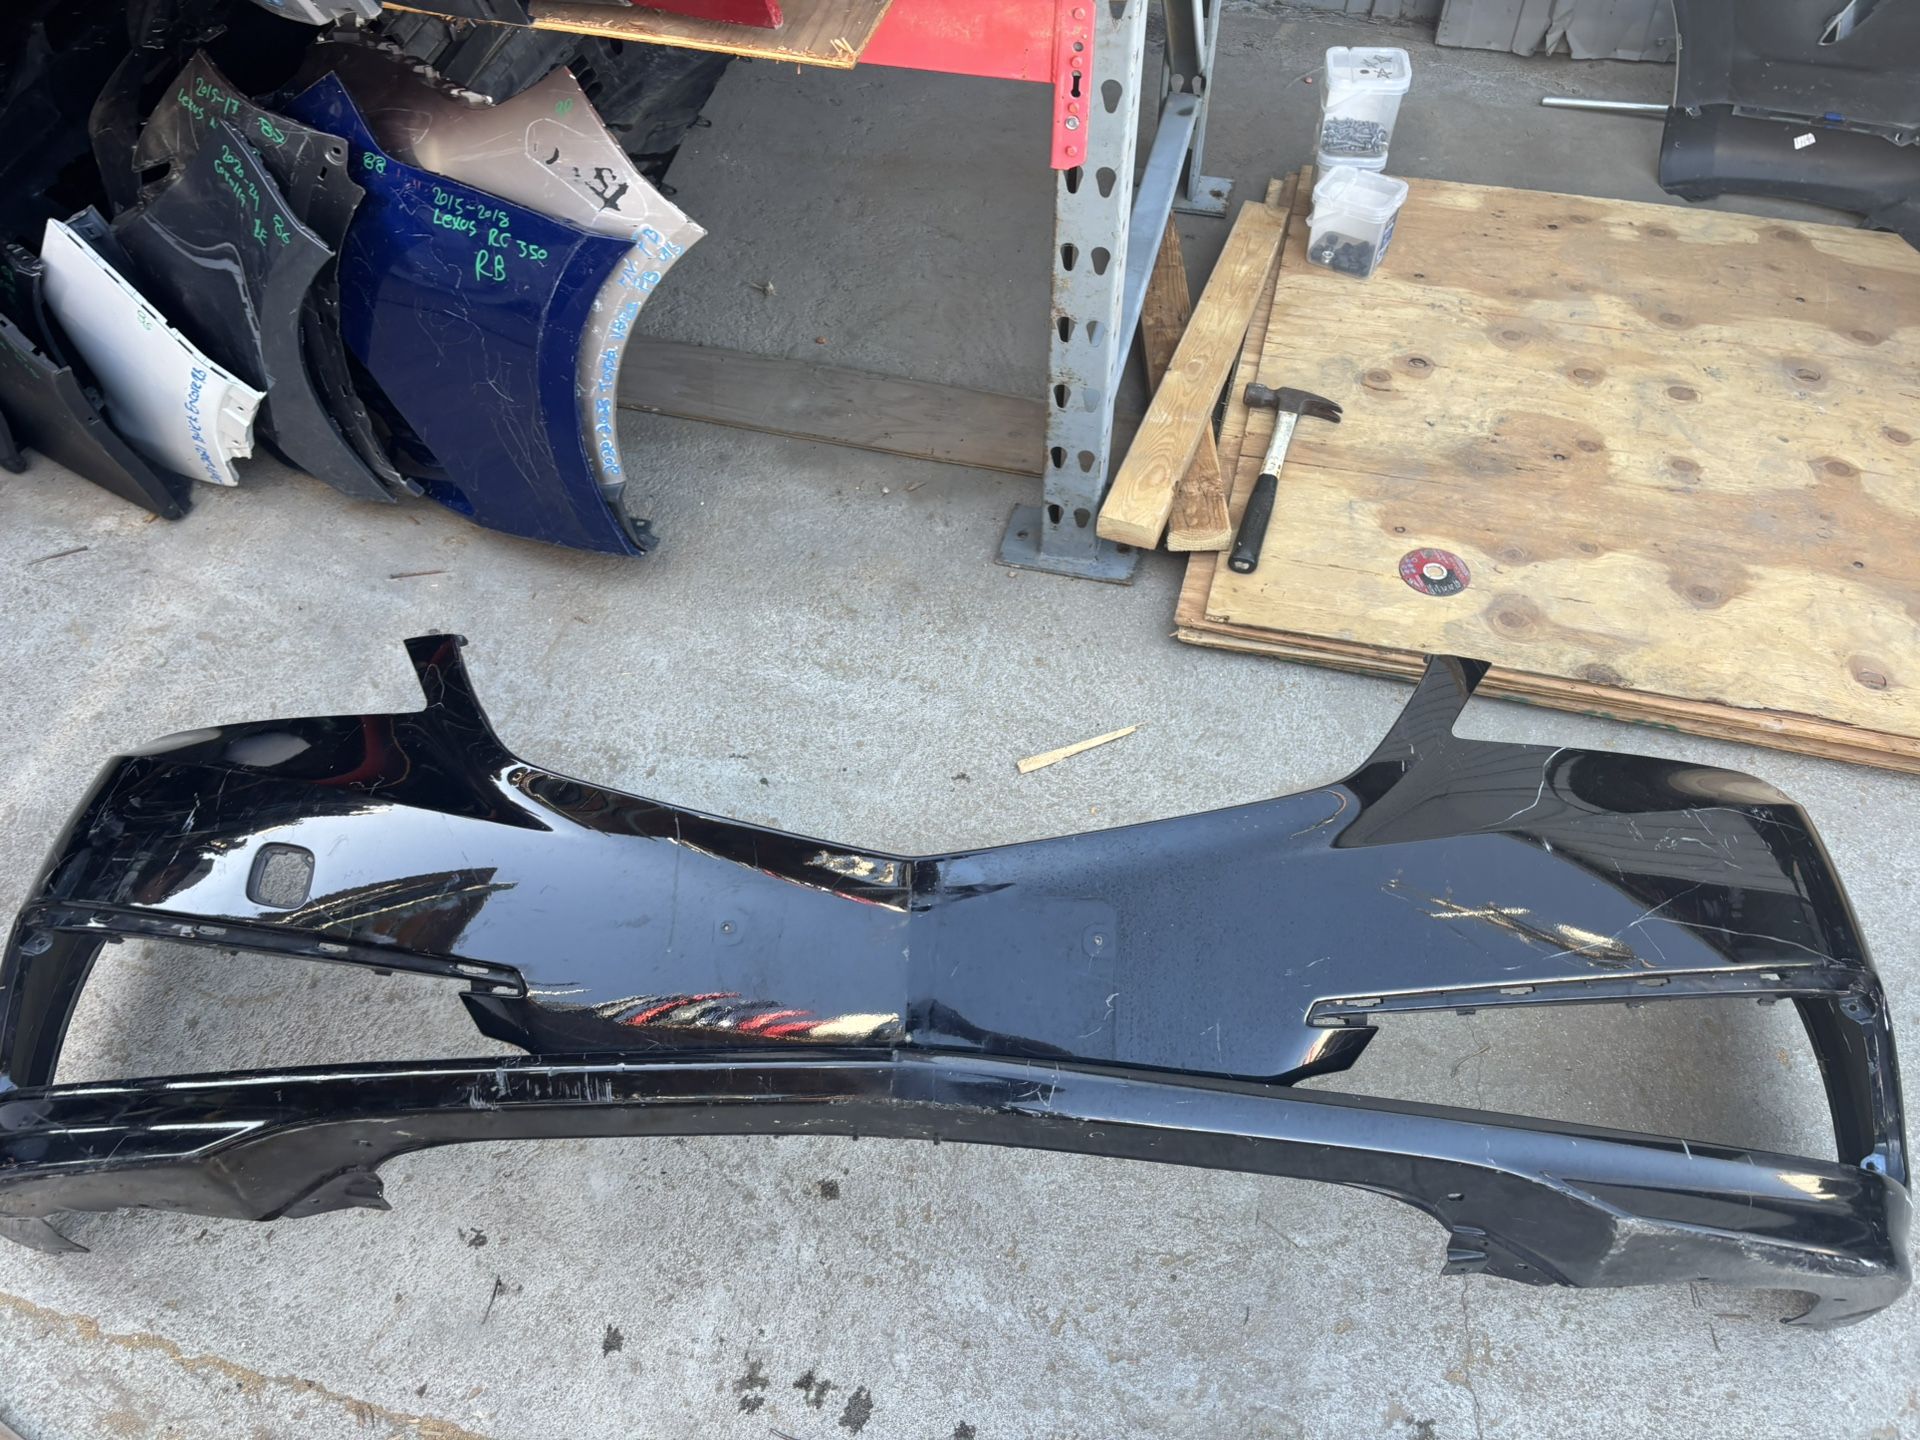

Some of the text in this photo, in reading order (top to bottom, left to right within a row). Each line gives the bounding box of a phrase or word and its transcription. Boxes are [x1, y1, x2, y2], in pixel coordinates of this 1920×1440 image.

[432, 186, 510, 228] 2015-2018
[433, 208, 548, 260] Lexus RC 350
[475, 249, 507, 281] RB
